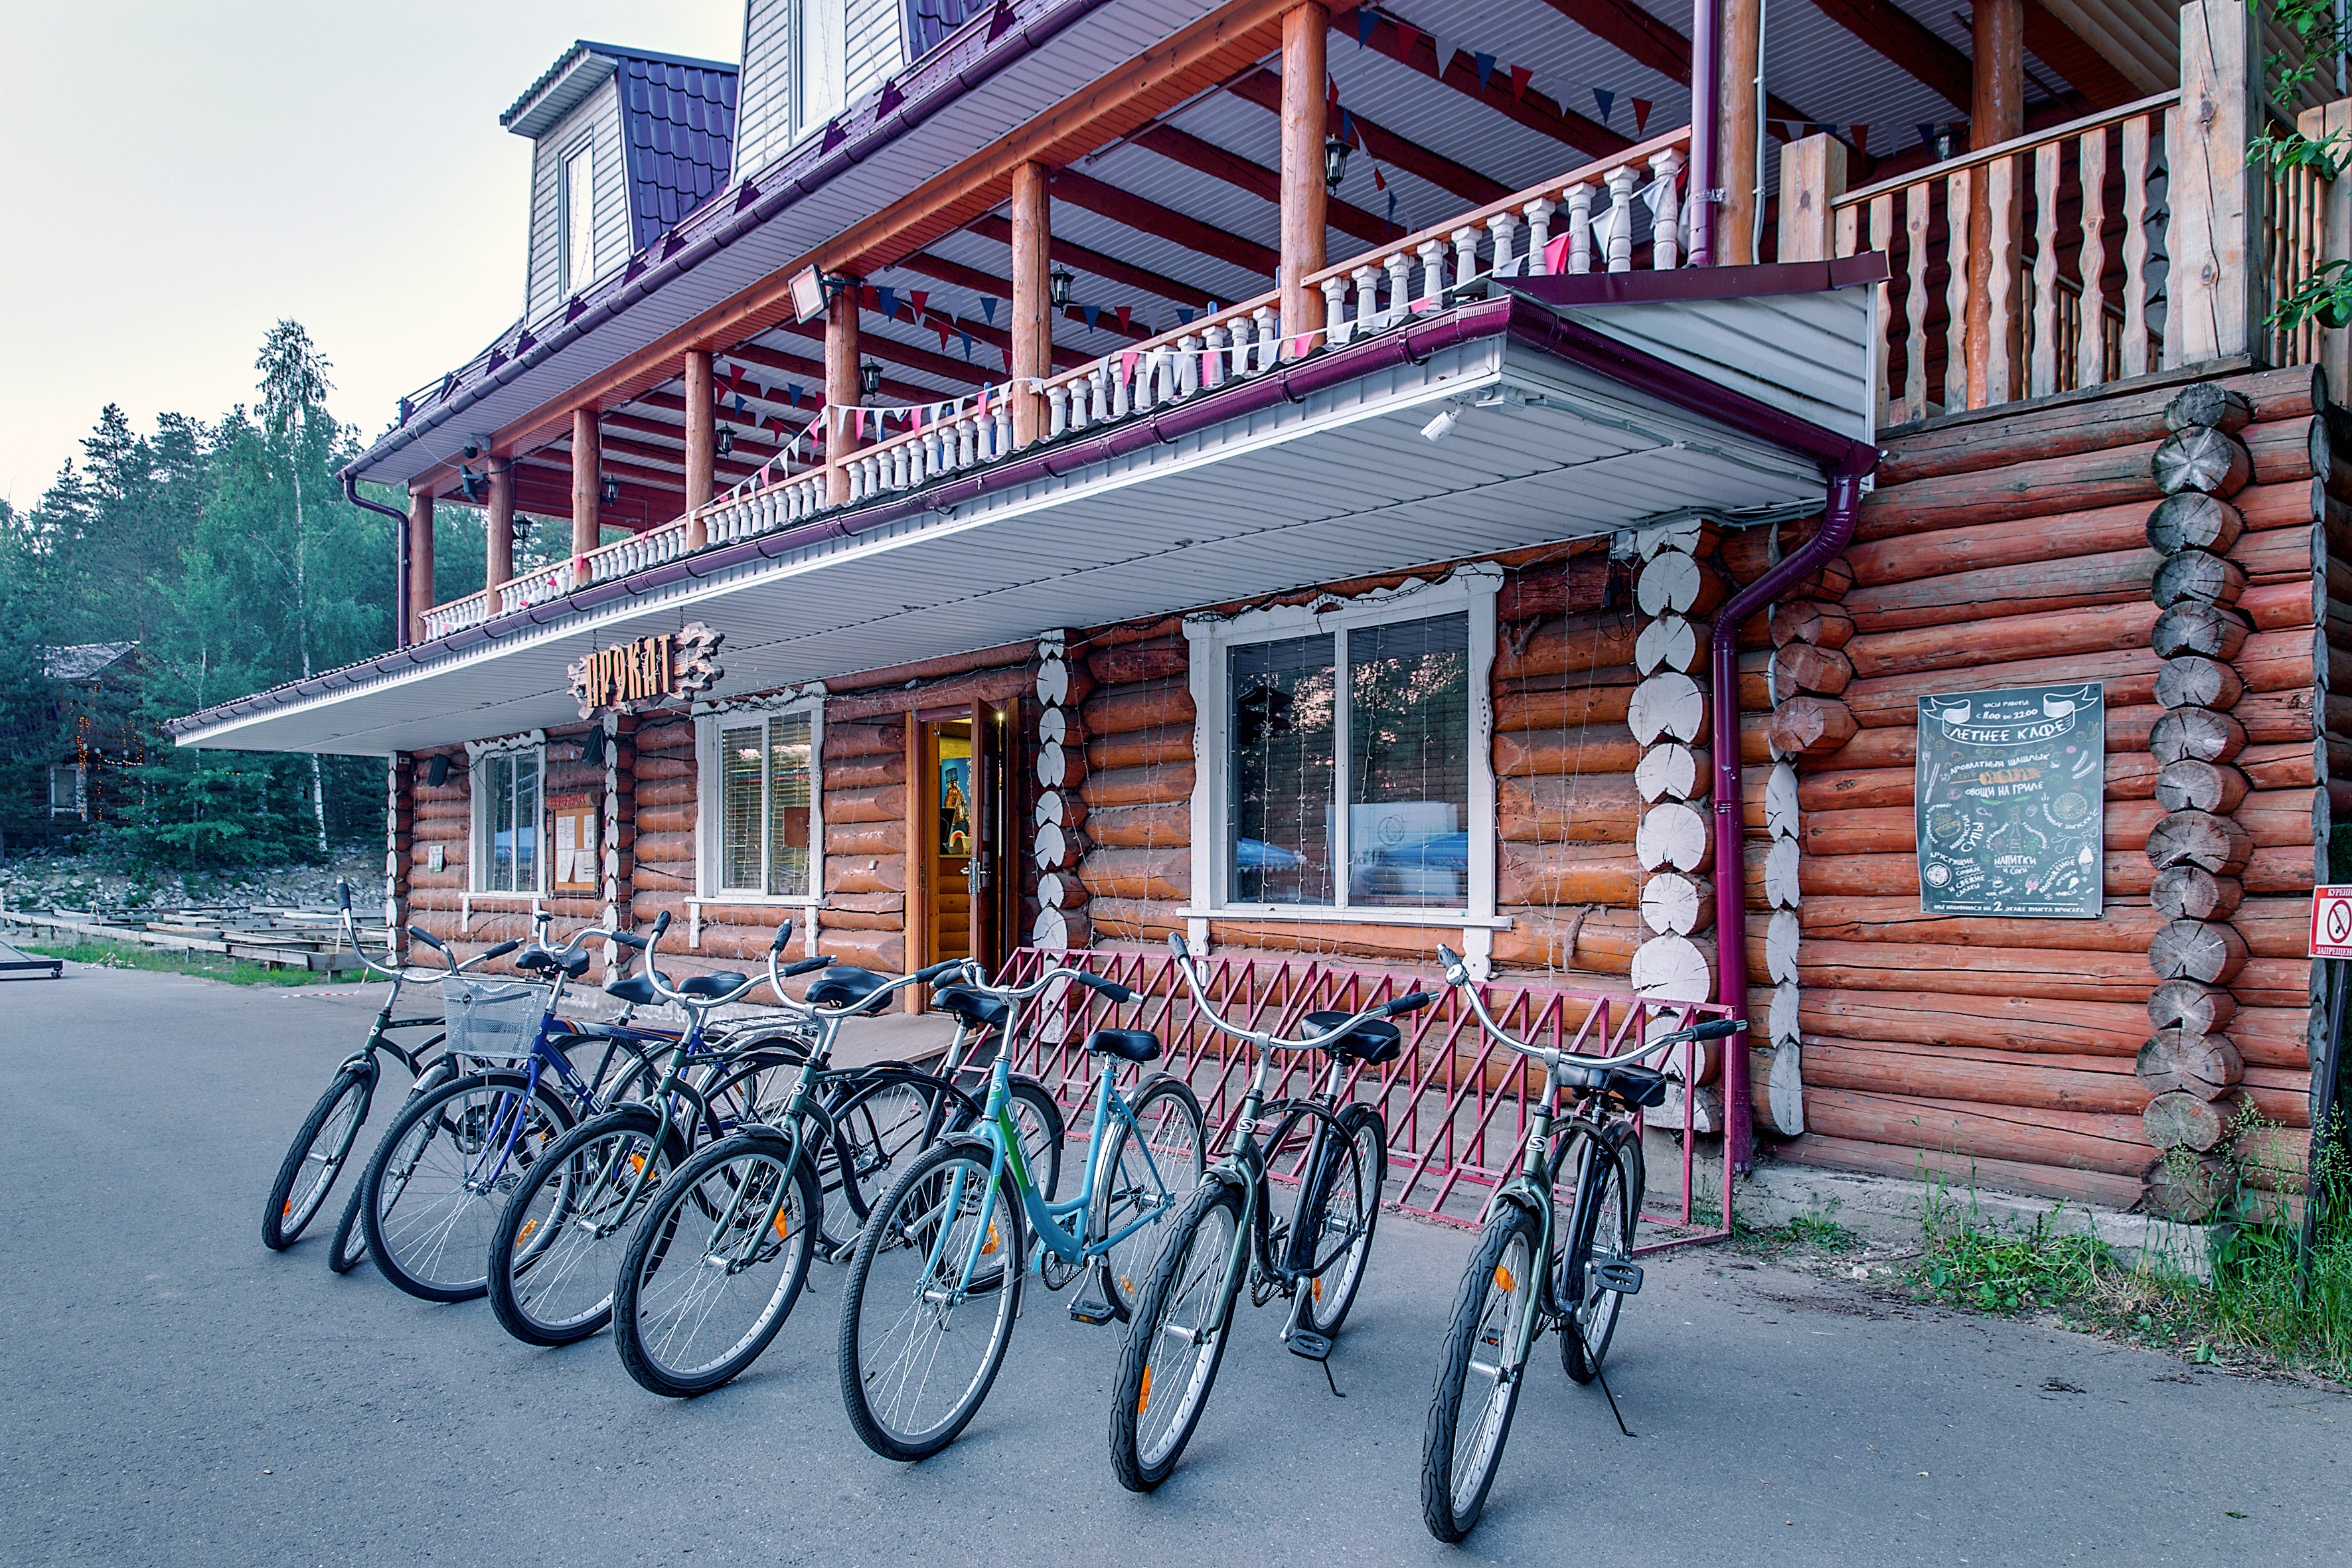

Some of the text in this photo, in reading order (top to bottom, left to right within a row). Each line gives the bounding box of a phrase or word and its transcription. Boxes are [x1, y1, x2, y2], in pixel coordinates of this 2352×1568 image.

[586, 634, 670, 708] ПРОКАТ
[1950, 720, 2067, 742] ЛЕТНЕЕ КАФЕ
[1950, 753, 2051, 775] АРОМАТНЫЙ ШАШЛЫК
[1965, 781, 2044, 798] ОВОЩИ НА ГРИЛЕ
[1960, 822, 1984, 852] СУПЫ
[1929, 852, 1974, 865] ХРУСТЯЩИЕ
[1994, 854, 2037, 865] НАПИТКИ
[1956, 875, 1985, 888] СВЕЖИЕ
[2038, 859, 2076, 894] МОРОЖЕНОЕ
[1993, 901, 2003, 912] 2
[824, 1073, 852, 1081] STELS
[566, 1067, 607, 1115] STE
[1263, 1105, 1280, 1115] STES
[1004, 1099, 1036, 1187] STELS
